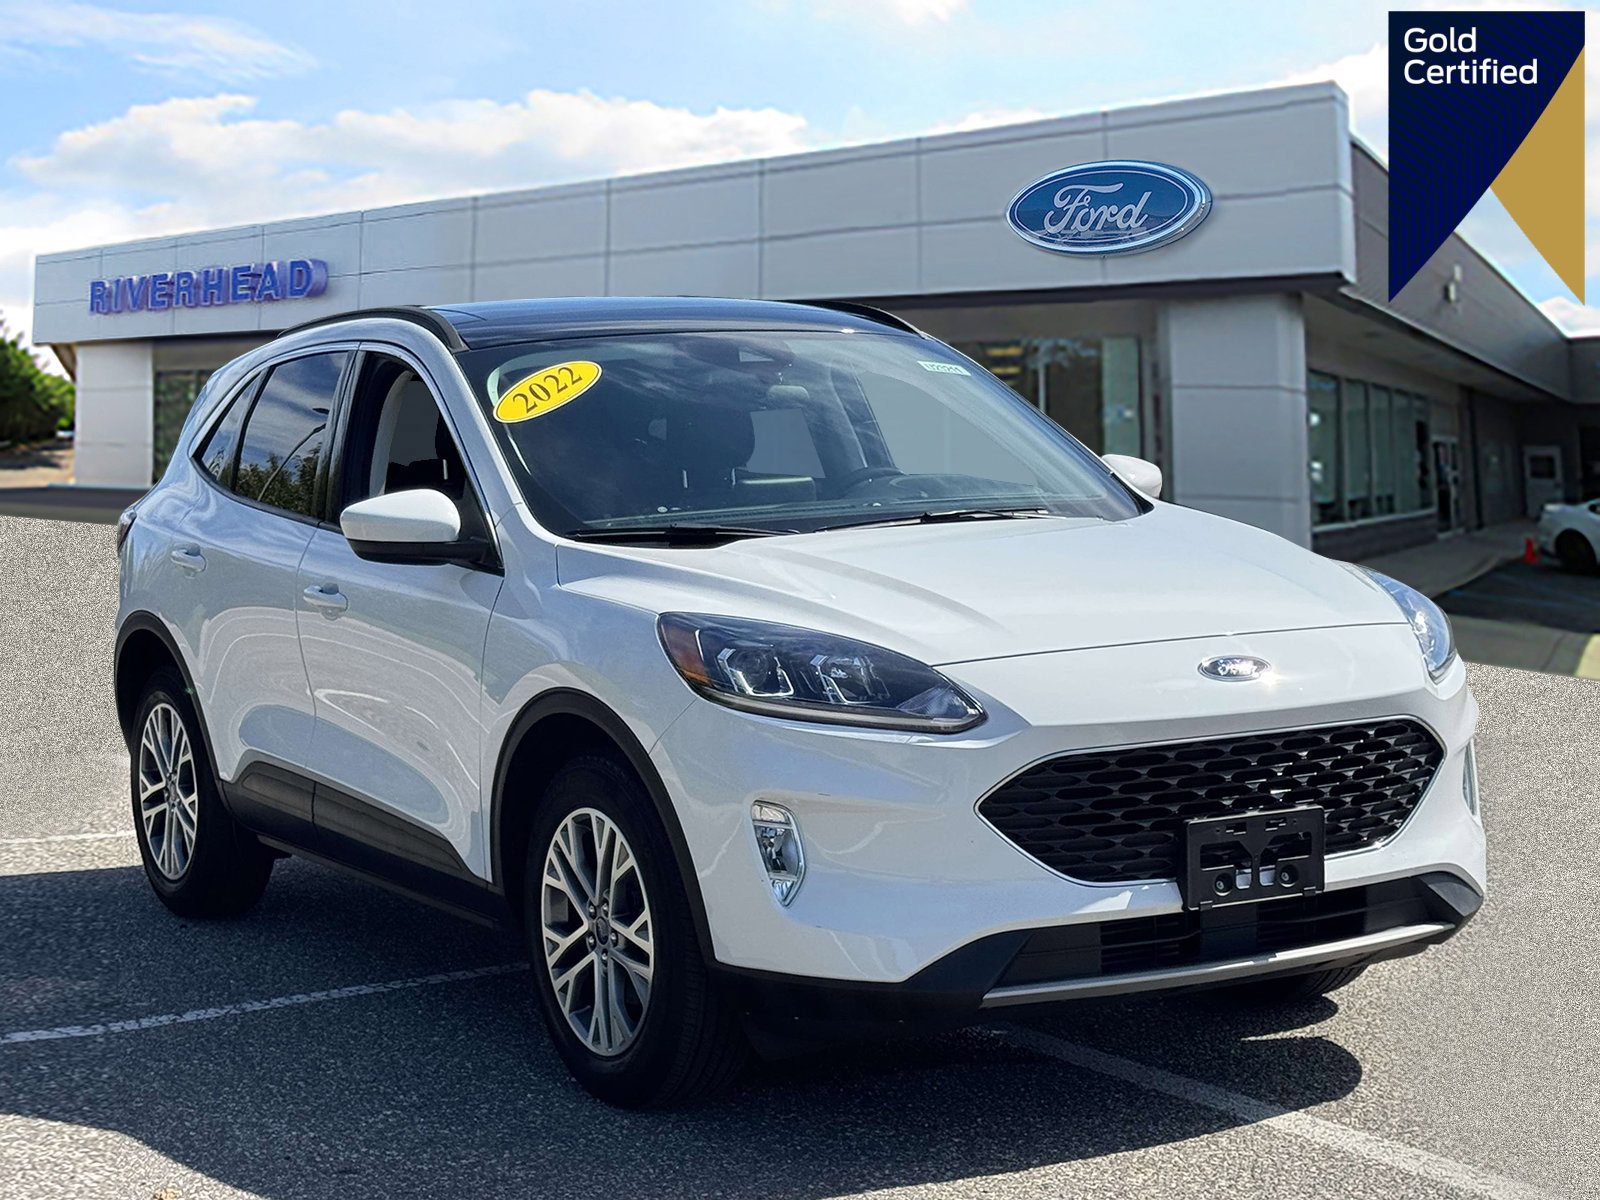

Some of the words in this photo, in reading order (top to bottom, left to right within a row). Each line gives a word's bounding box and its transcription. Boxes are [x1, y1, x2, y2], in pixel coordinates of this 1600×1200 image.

[1043, 182, 1152, 234] Ford
[89, 259, 317, 315] RIVERHEAD
[512, 366, 583, 414] 2022
